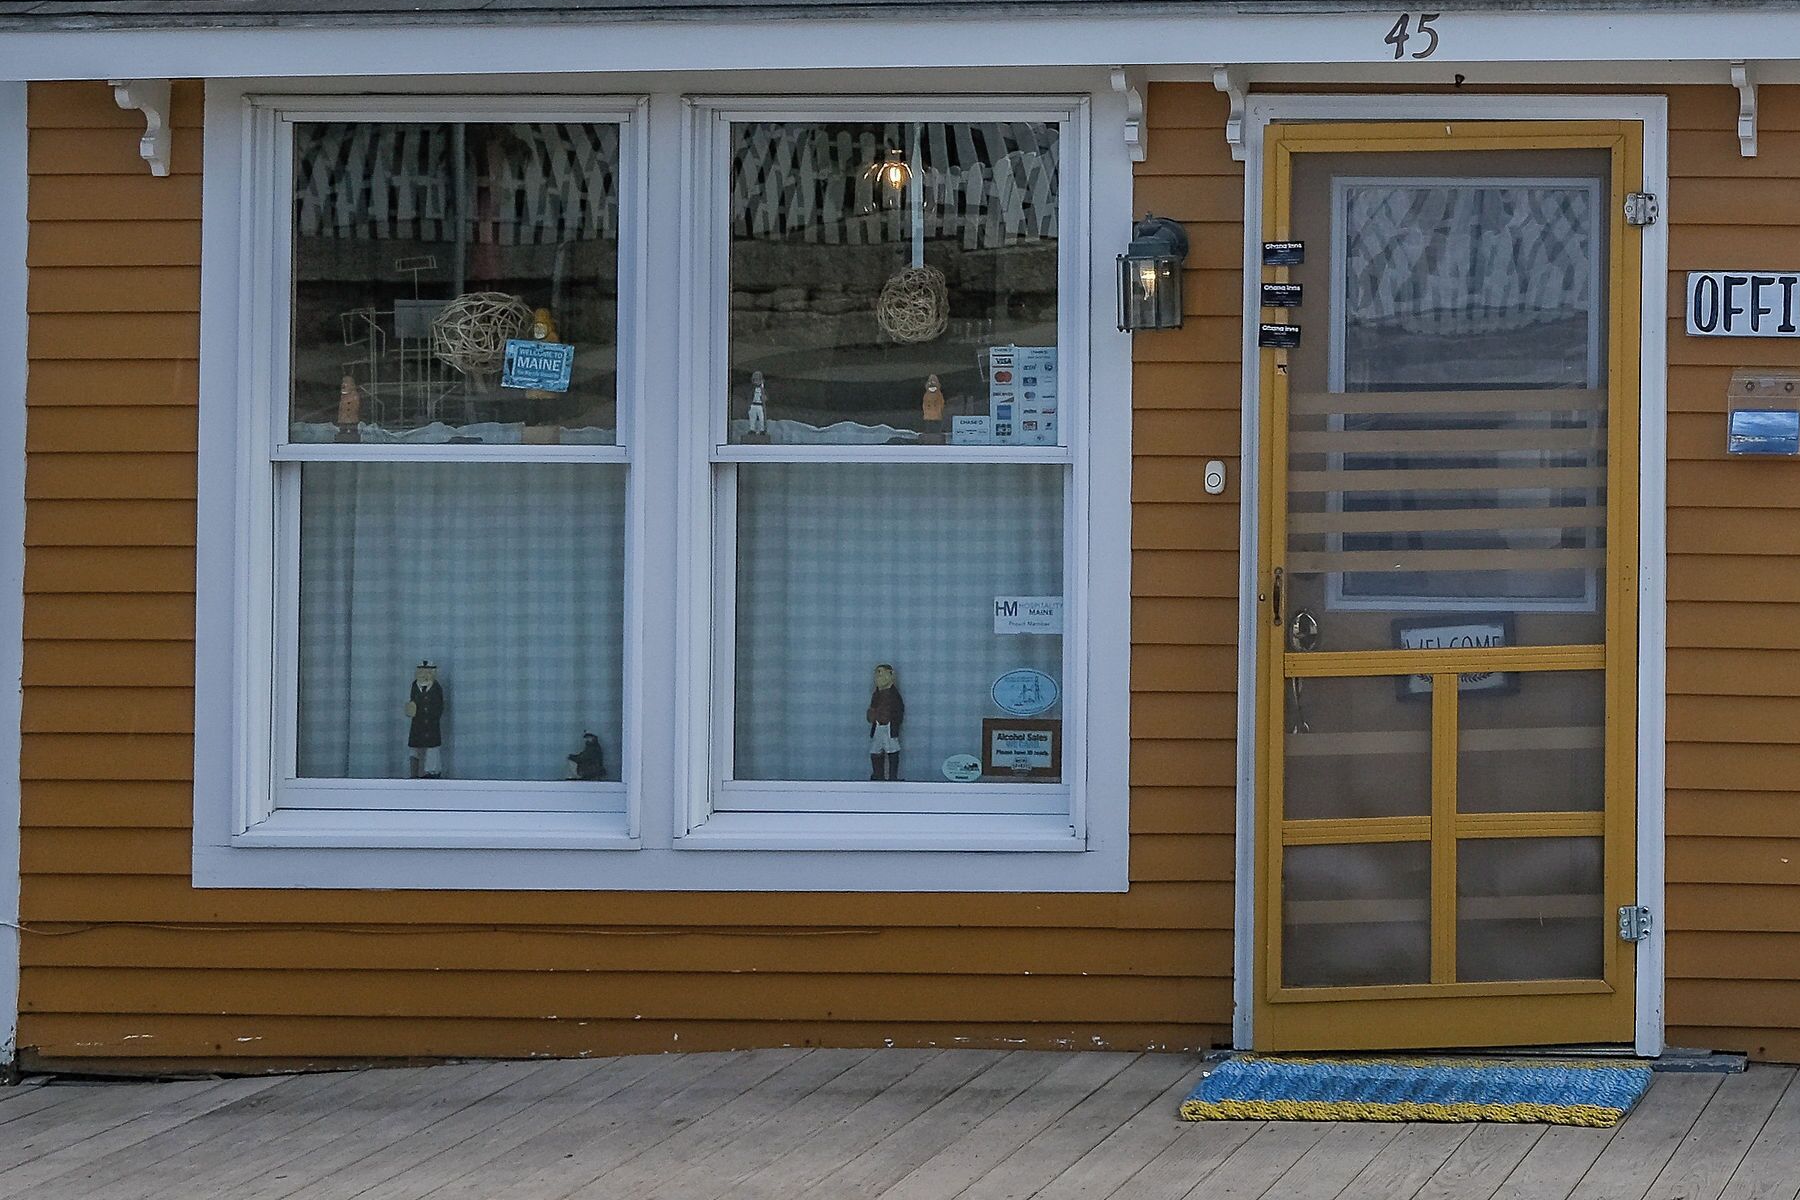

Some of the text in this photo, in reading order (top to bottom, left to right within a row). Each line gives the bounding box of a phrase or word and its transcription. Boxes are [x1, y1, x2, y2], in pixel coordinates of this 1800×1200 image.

[1384, 13, 1440, 60] 45
[517, 356, 561, 372] MAINE
[995, 601, 1018, 616] HM
[996, 733, 1048, 741] Alcohol Sales
